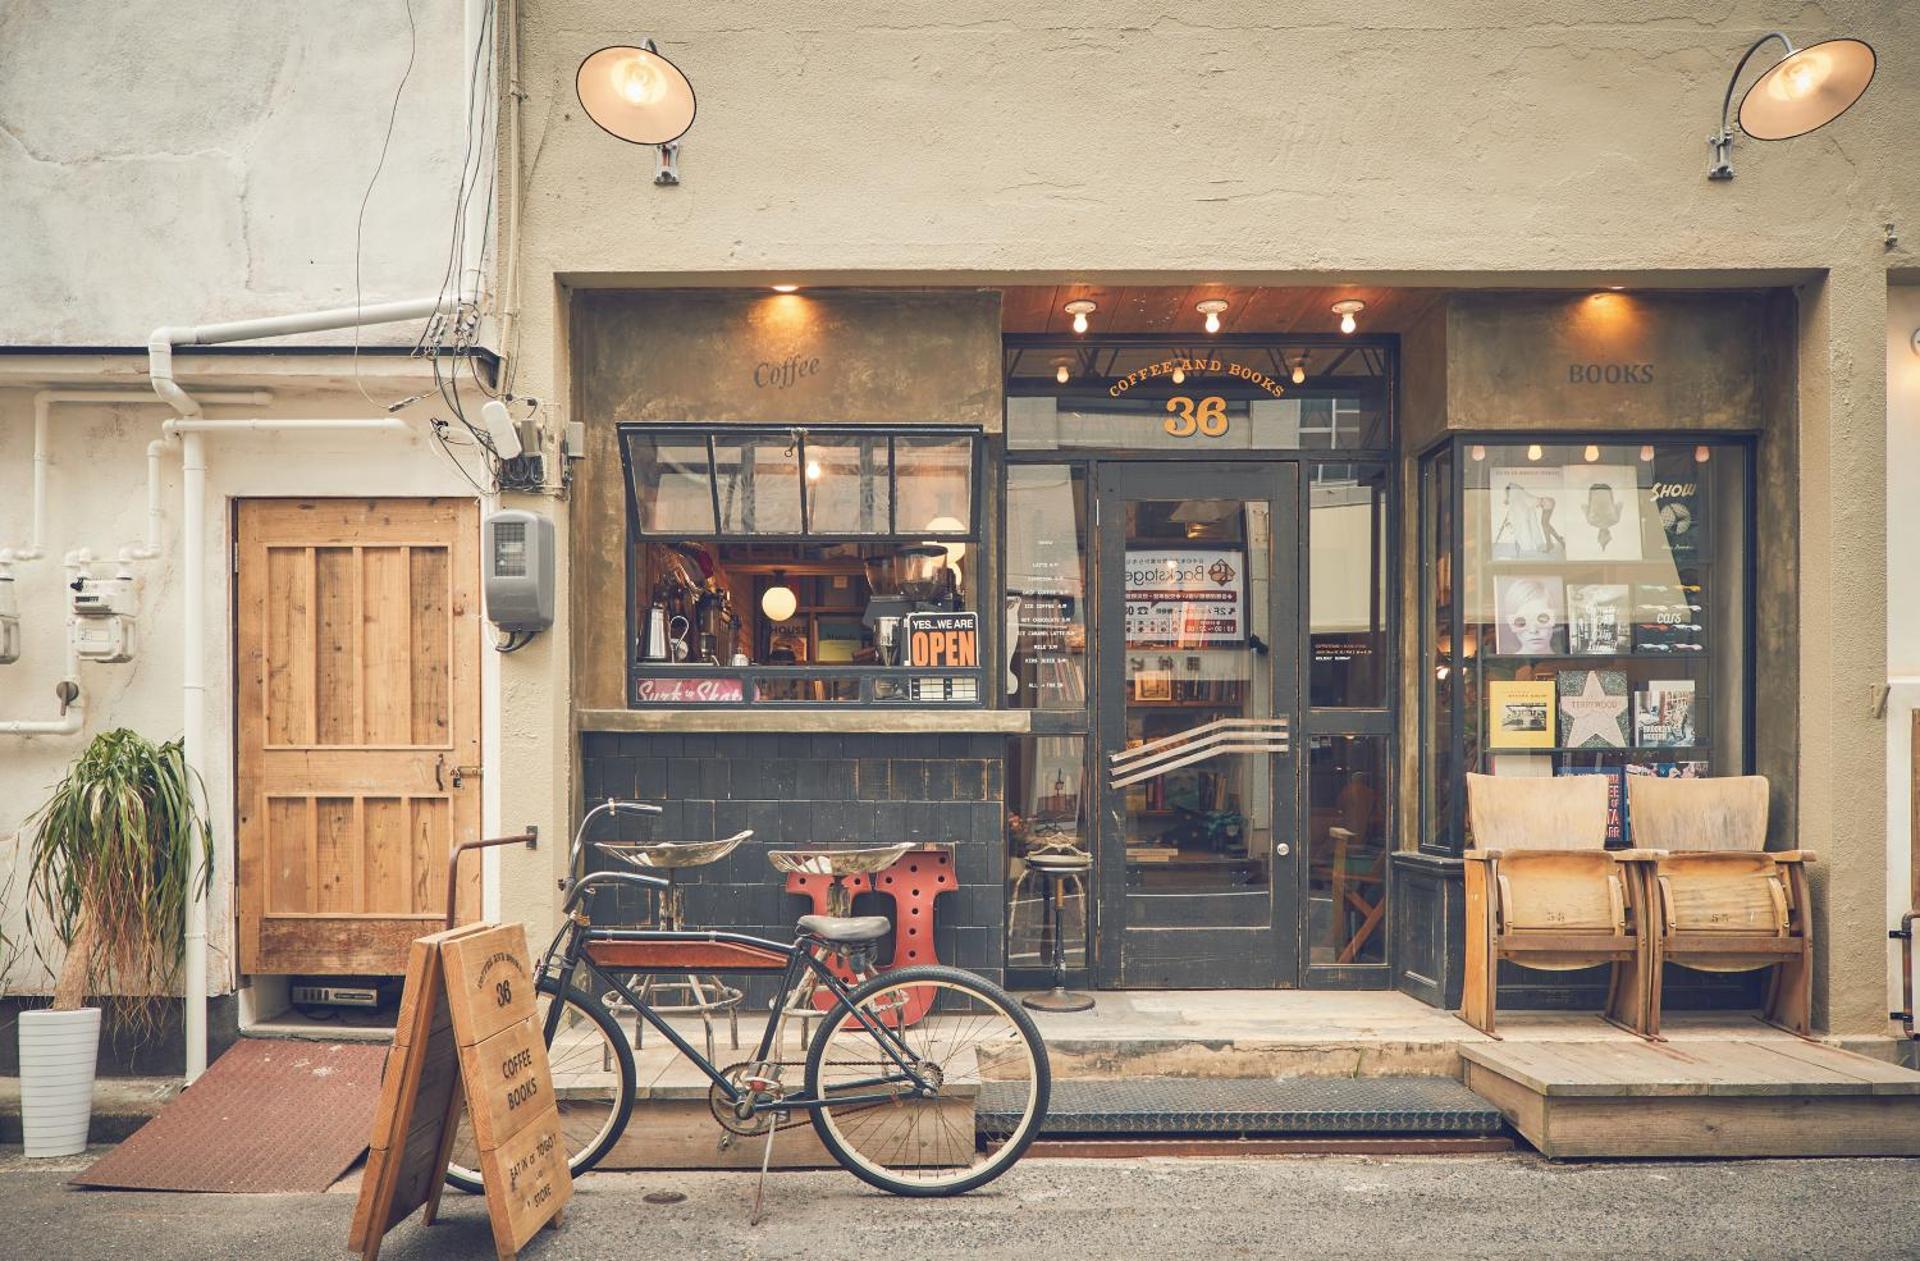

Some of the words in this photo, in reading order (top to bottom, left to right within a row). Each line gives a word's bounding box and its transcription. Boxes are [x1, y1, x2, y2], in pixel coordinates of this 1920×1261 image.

[754, 354, 820, 389] Coffee
[1109, 362, 1173, 397] COFFEE
[1181, 358, 1222, 372] AND
[1228, 363, 1286, 398] BOOKS
[1568, 363, 1654, 384] BOOKS
[1163, 396, 1229, 437] 36
[1650, 482, 1697, 502] SHOW
[937, 619, 953, 629] WE
[953, 618, 974, 629] ARE
[912, 631, 975, 667] OPEN
[496, 979, 512, 1008] 36
[502, 1048, 532, 1079] COFFEE
[507, 1077, 537, 1111] BOOKS
